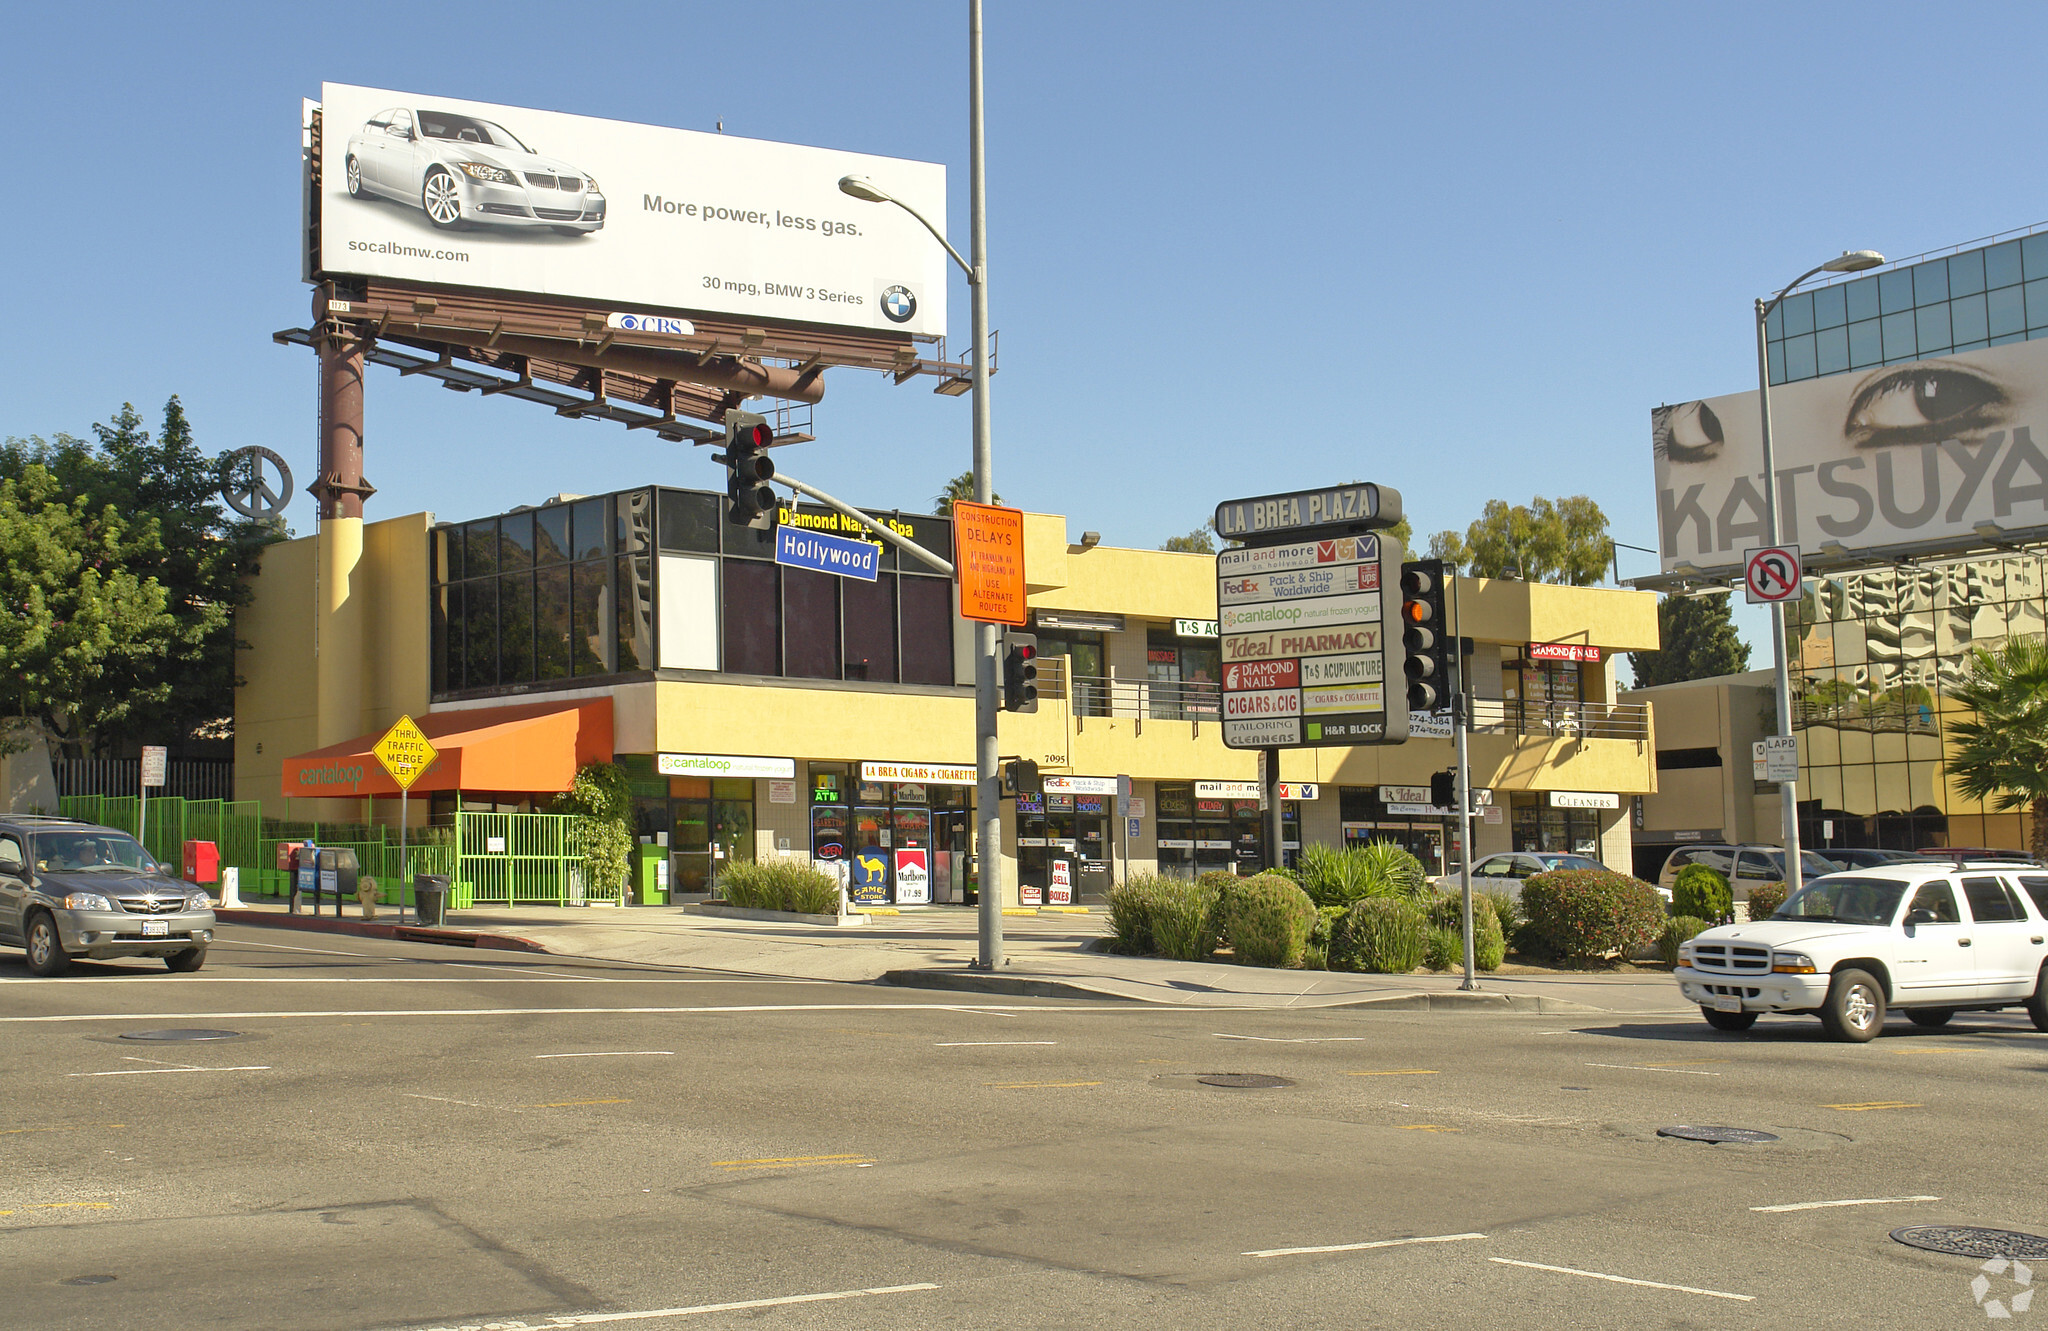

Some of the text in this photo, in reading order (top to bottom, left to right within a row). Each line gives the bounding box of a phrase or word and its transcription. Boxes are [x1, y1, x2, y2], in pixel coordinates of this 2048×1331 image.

[643, 193, 864, 237] More power, less gas.
[348, 240, 469, 262] socalbmw.com
[702, 276, 864, 305] 30 mpg, BMW 3 Series
[331, 301, 347, 311] 1173
[641, 316, 682, 334] CBS
[1660, 426, 2048, 558] KATSUYA
[1224, 488, 1371, 534] LA BREA PLAZA
[778, 508, 838, 531] Diamond
[888, 519, 914, 538] Spa
[961, 511, 1018, 528] CONSTRUCTION
[967, 528, 1012, 546] DELAYS
[785, 535, 872, 571] Hollywood
[1221, 546, 1314, 565] mail and more
[1252, 558, 1315, 571] on hollywood
[985, 579, 1001, 589] USE
[1269, 570, 1334, 587] Pack & Ship
[1362, 572, 1376, 585] ups
[1224, 579, 1259, 595] FedEx
[1273, 583, 1330, 598] Worldwide
[973, 589, 1014, 603] ALTERNATE
[979, 601, 1008, 614] ROUTES
[1236, 603, 1379, 625] cantaloop natural frozen yogurt
[1179, 621, 1199, 635] T&S
[1226, 630, 1378, 659] Ideal PHARMACY
[1577, 648, 1598, 659] NAILS
[1323, 659, 1382, 679] ACUPUNCTURE
[1243, 676, 1276, 688] NAILS
[1228, 695, 1270, 714] CIGARS
[1271, 702, 1277, 712] &
[1277, 694, 1297, 711] CIG
[1315, 693, 1338, 703] CIGARS
[1344, 692, 1379, 702] CIGARETTE
[1232, 720, 1293, 731] TAILORING
[1325, 723, 1382, 736] H&R BLOCK
[395, 729, 418, 739] THRU
[1231, 733, 1295, 744] CLEANERS
[387, 740, 424, 752] TRAFFIC
[1768, 739, 1795, 749] LAPD
[387, 753, 423, 764] MERGE
[673, 757, 731, 773] cantaloop
[1045, 754, 1065, 764] 7095
[393, 766, 418, 776] LEFT
[1755, 762, 1764, 770] 217
[299, 761, 364, 793] cantaloop
[866, 766, 875, 776] LA
[878, 766, 898, 778] BREA
[901, 767, 928, 779] CIGARS
[937, 769, 977, 781] CIGARETTE
[1046, 778, 1070, 787] FedEx
[1093, 779, 1105, 787] Ship
[1200, 783, 1222, 791] mail
[1225, 783, 1242, 792] and
[815, 791, 839, 801] ATM
[899, 789, 924, 801] Marlboro
[1049, 796, 1072, 805] FedEx
[1395, 786, 1427, 802] Ideal
[1077, 803, 1101, 811] PHOTOS
[1198, 801, 1223, 810] NOTARY
[1558, 795, 1611, 808] CLEANERS
[818, 846, 842, 856] OPEN
[1055, 863, 1066, 872] WE
[898, 869, 927, 882] Marlboro
[1053, 875, 1068, 886] SELL
[854, 885, 887, 895] CAMEL
[1049, 890, 1069, 902] BOXES
